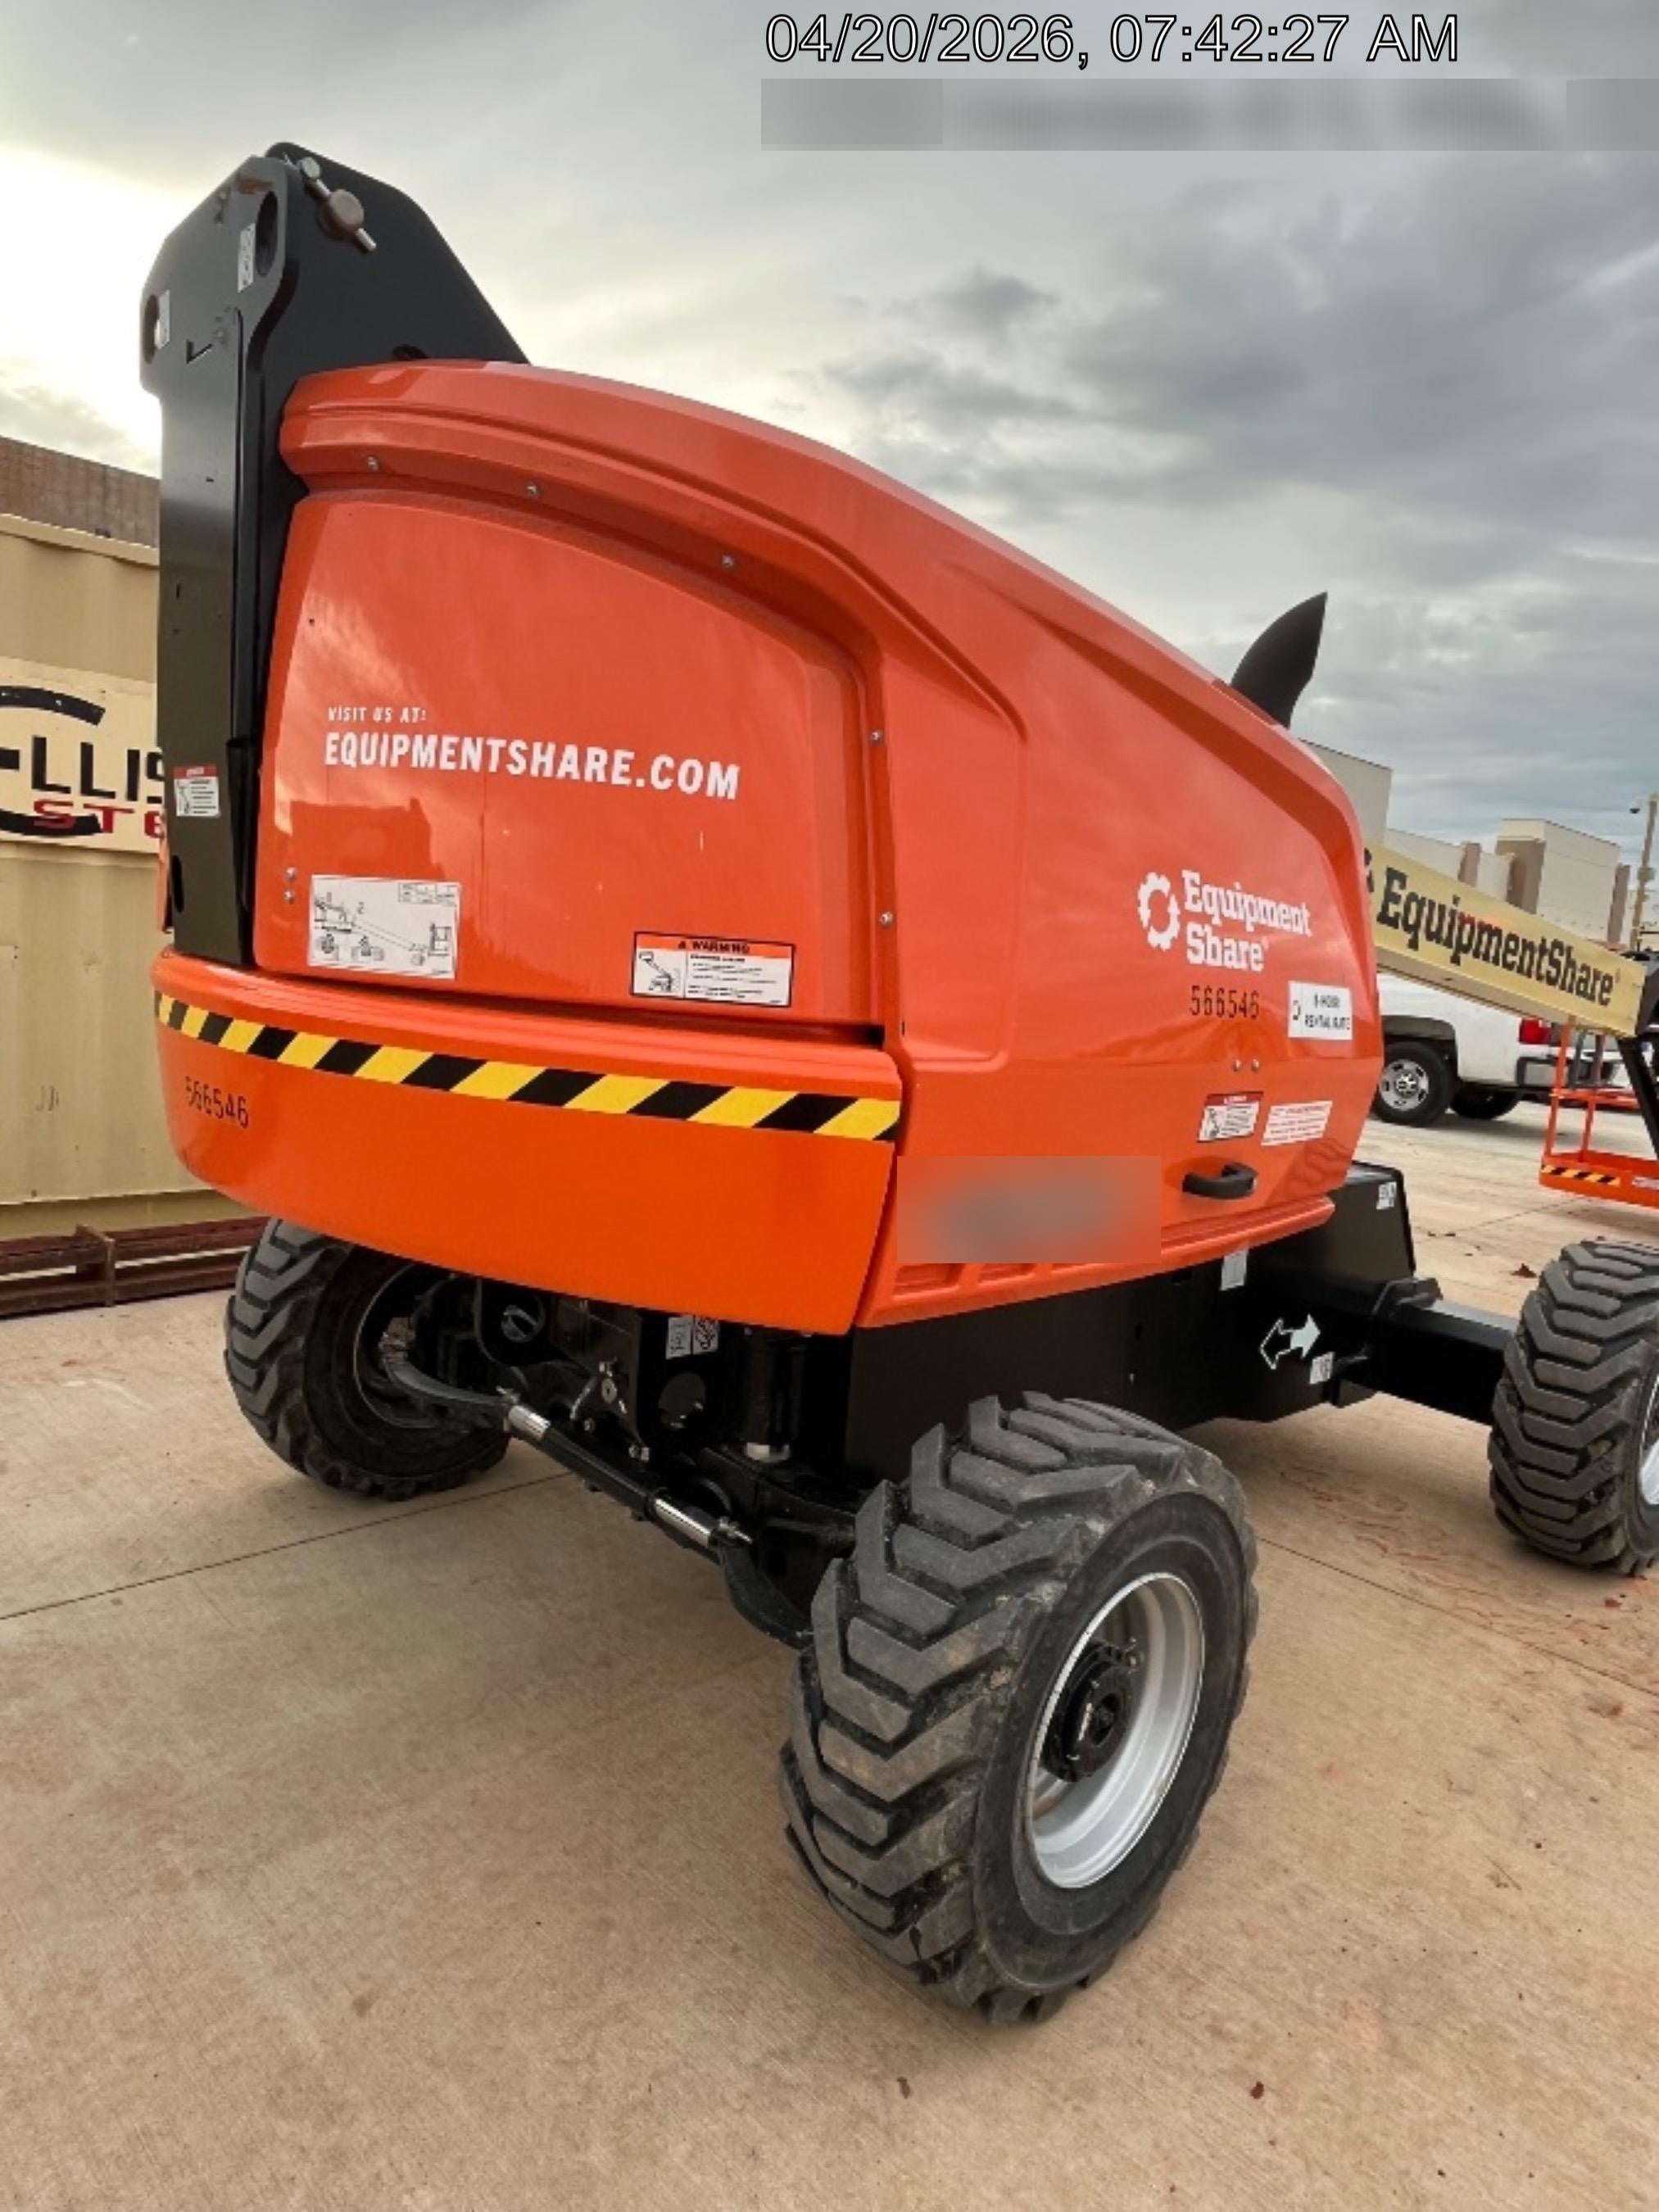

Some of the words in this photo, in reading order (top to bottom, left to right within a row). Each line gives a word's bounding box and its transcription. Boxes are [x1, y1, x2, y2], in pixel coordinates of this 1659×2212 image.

[328, 705, 366, 722] VISIT
[373, 707, 393, 723] US
[400, 707, 427, 723] AT:
[324, 732, 739, 800] EQUIPMENTSHARE.COM
[1181, 869, 1311, 936] Equipment
[1186, 922, 1264, 972] Share
[1376, 867, 1615, 1007] EquipmentShare
[1190, 985, 1260, 1019] 566546
